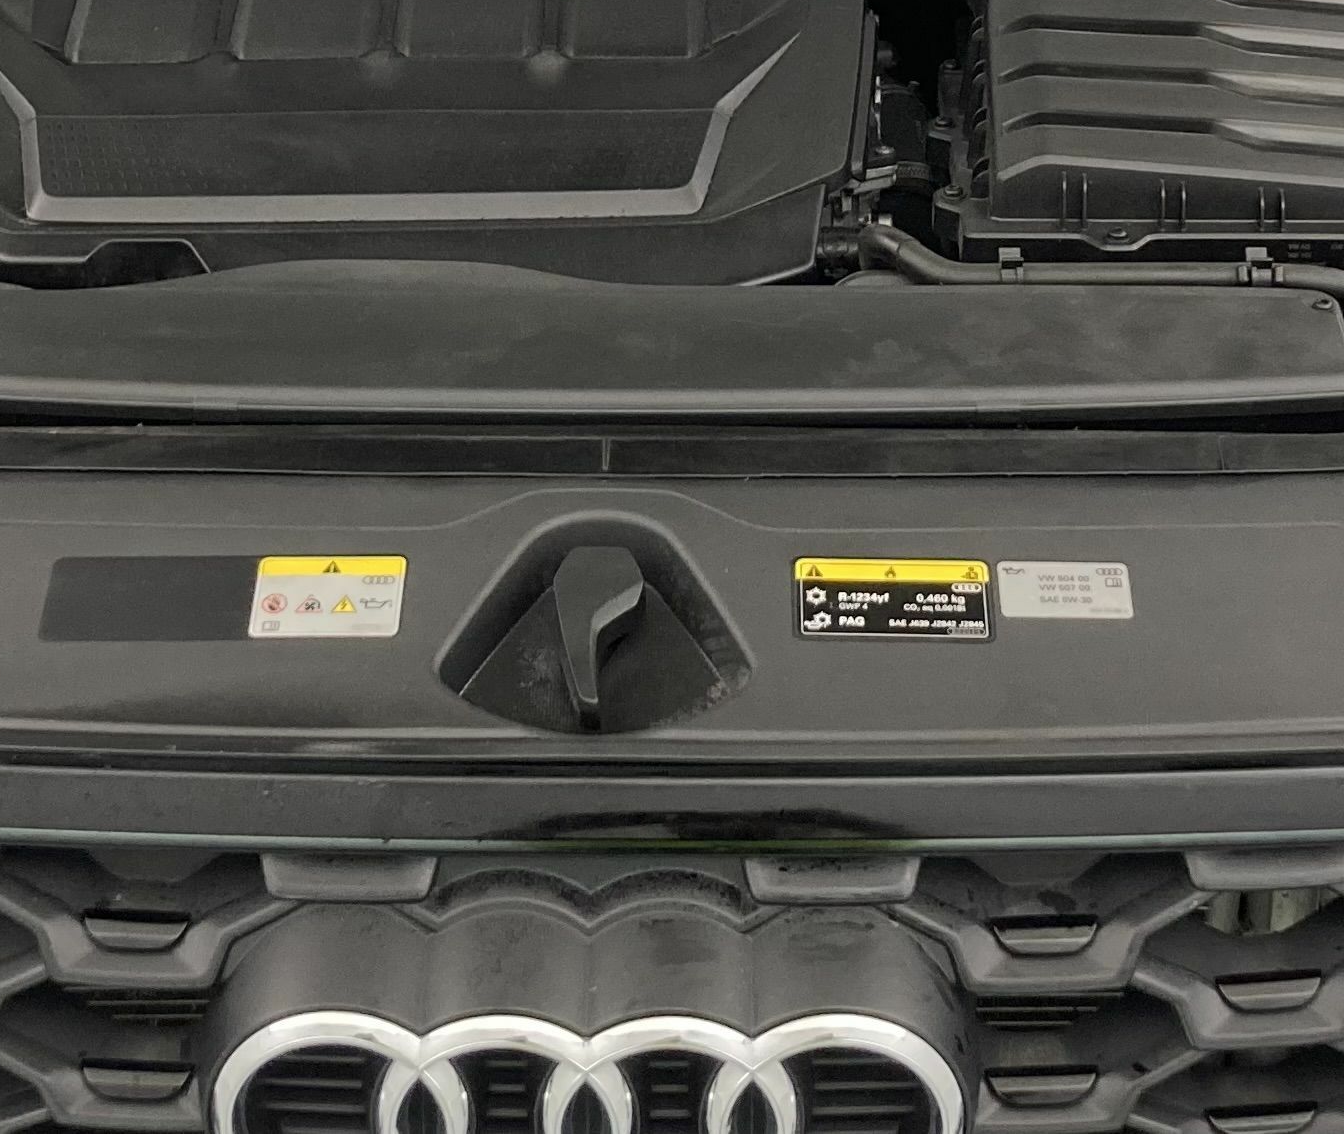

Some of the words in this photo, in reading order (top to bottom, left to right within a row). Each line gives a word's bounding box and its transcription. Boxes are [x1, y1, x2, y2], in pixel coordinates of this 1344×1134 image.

[1038, 574, 1055, 582] VW
[838, 591, 889, 604] R-1234yf
[951, 593, 966, 605] kg
[838, 616, 865, 627] PAG
